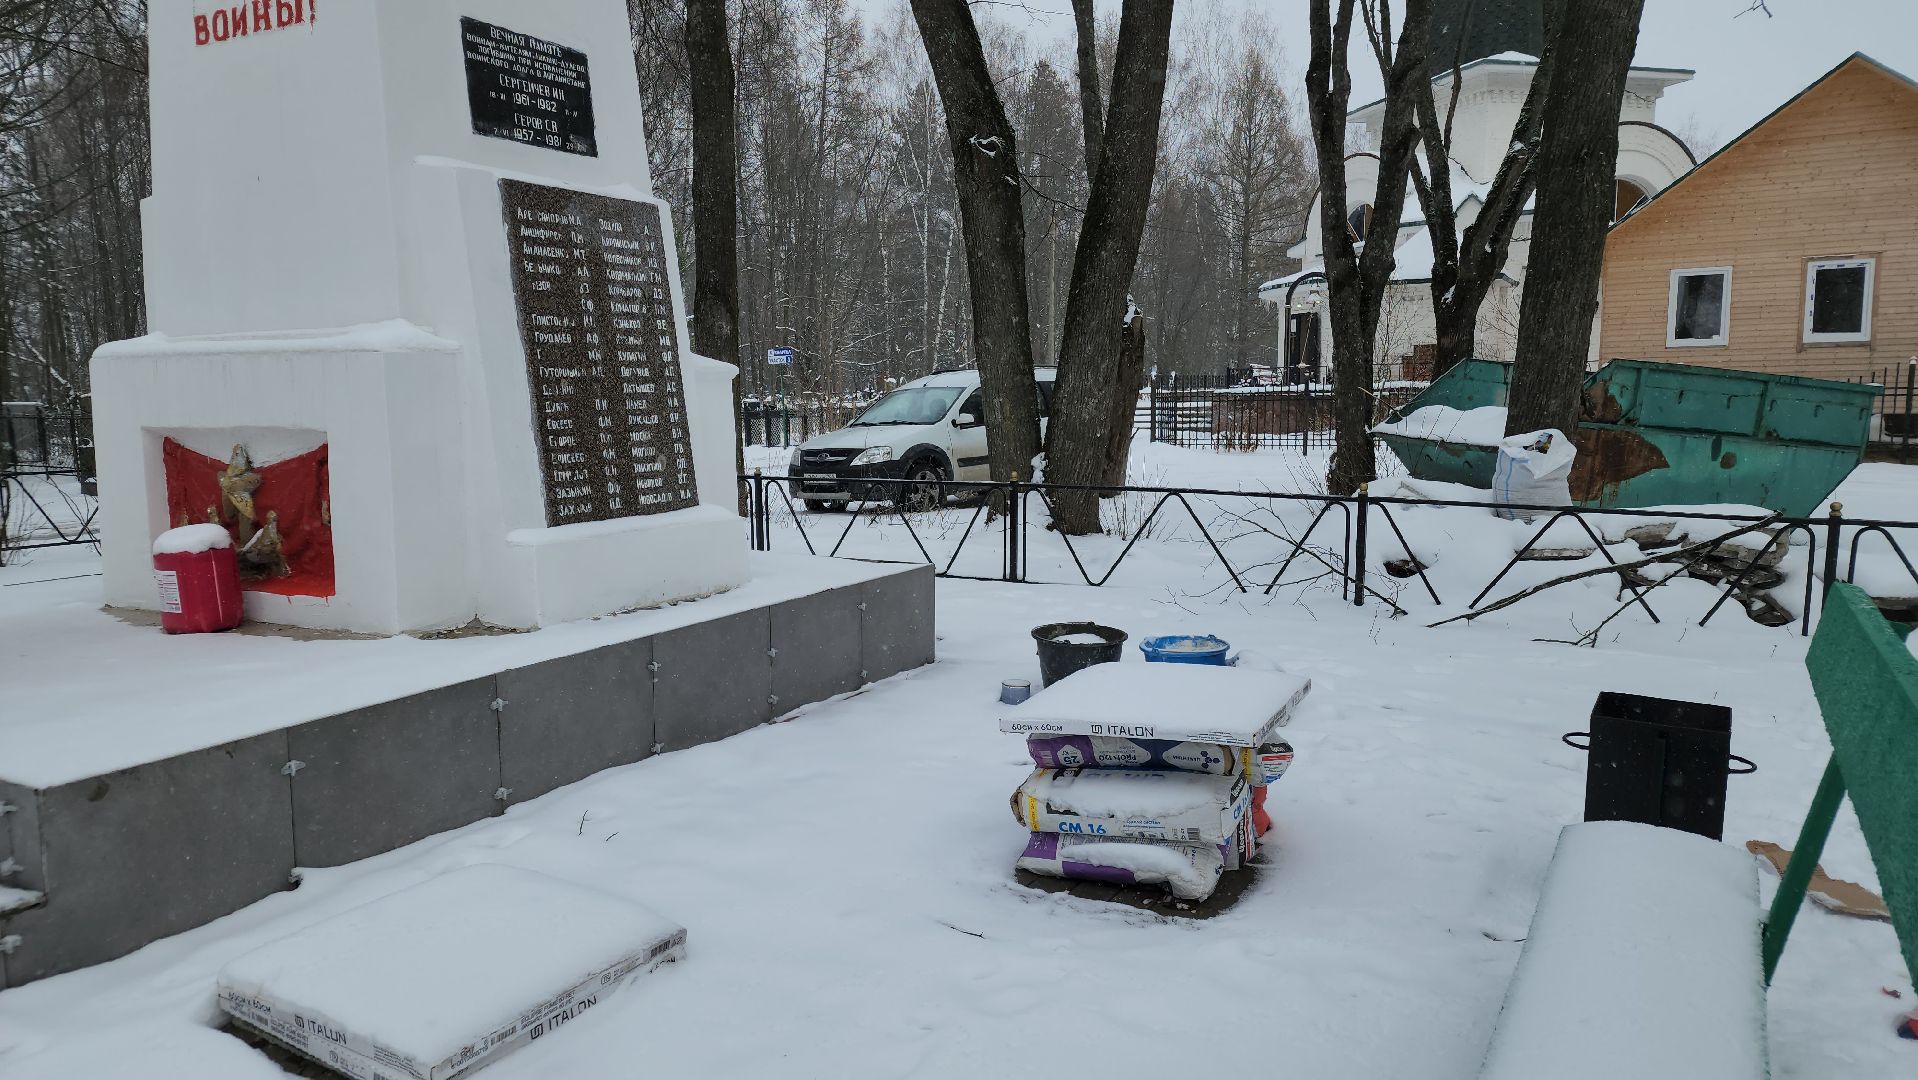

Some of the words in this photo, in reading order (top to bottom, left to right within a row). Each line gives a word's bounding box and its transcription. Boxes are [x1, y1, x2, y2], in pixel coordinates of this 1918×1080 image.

[491, 27, 525, 46] ВЕЧНАЯ
[530, 38, 562, 57] ПАМЯТЬ
[514, 112, 542, 129] СЕРОВ
[514, 128, 534, 141] 1957
[546, 134, 562, 147] 1981
[1107, 725, 1154, 737] ITALON
[1058, 822, 1083, 833] CM
[1088, 823, 1106, 834] 16
[548, 996, 597, 1030] ITALON
